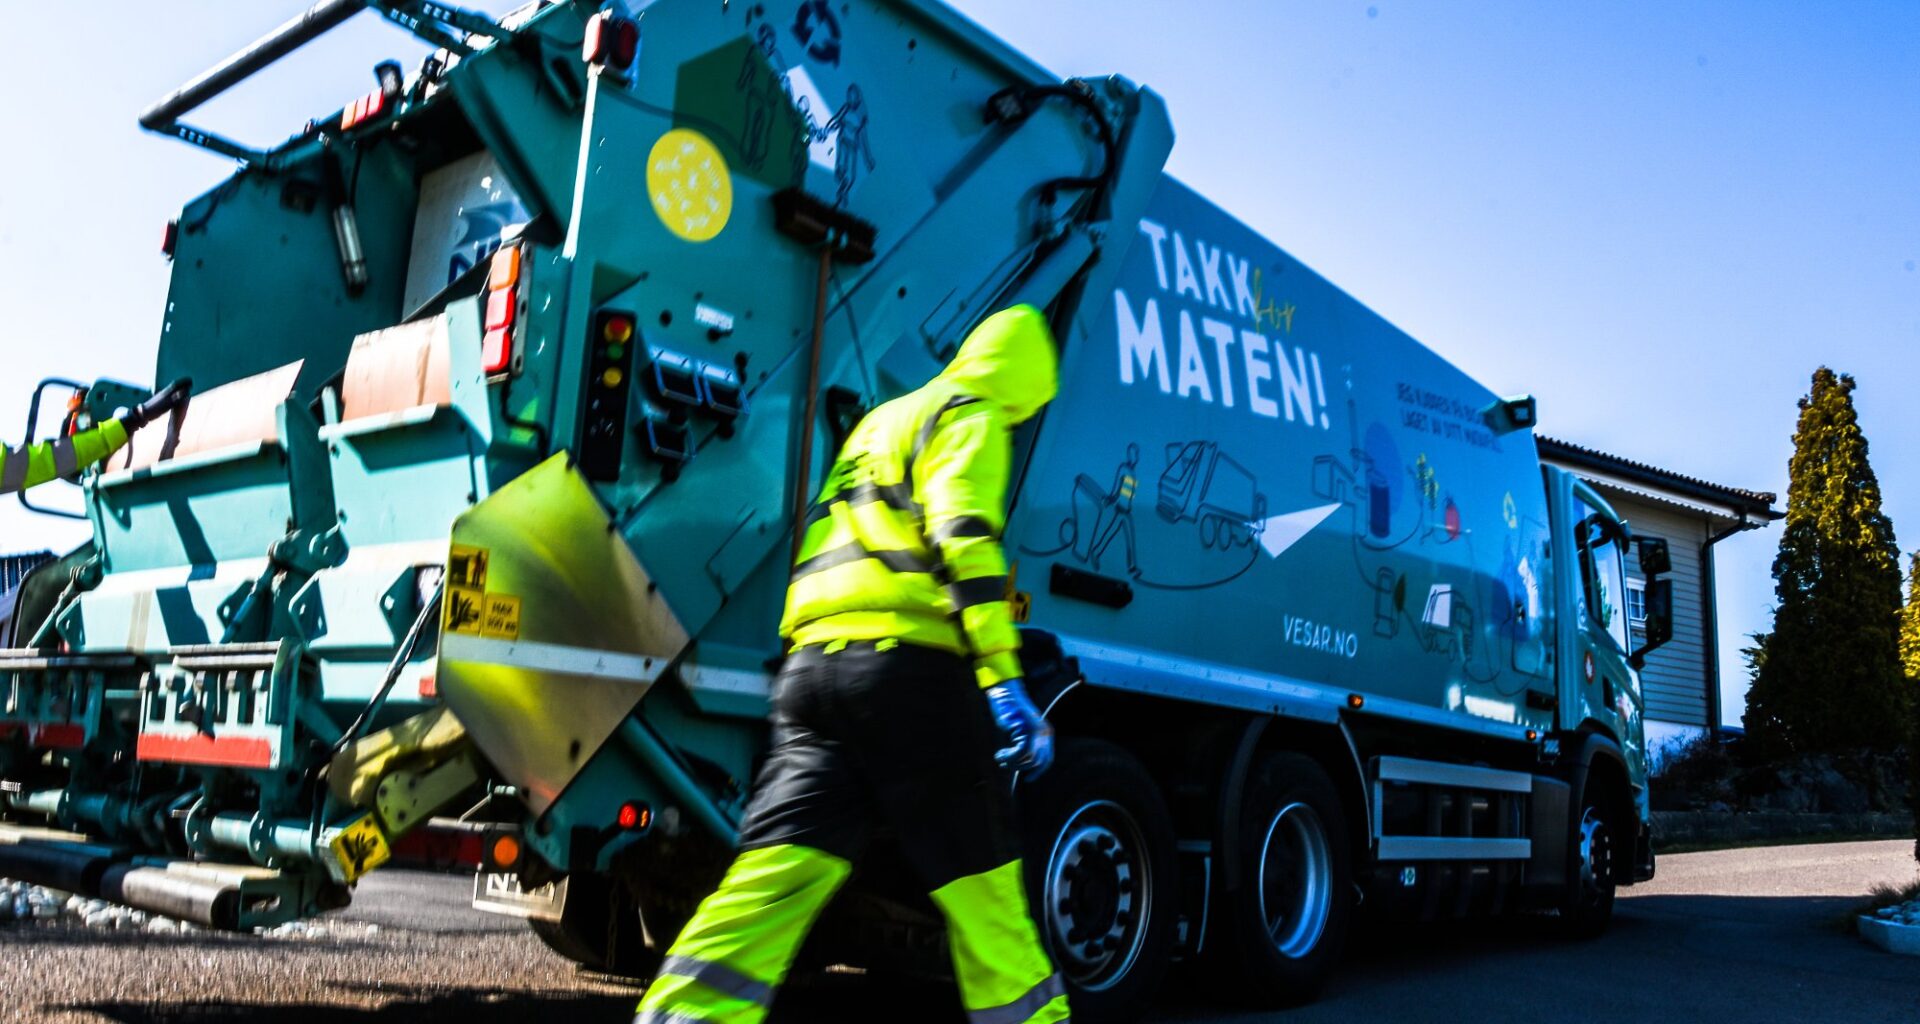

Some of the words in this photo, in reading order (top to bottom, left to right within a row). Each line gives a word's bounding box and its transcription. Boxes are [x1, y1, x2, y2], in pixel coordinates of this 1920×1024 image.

[1139, 217, 1262, 324] TAKK
[1114, 287, 1330, 430] MATEN!
[1283, 613, 1359, 658] VESAR.NO
